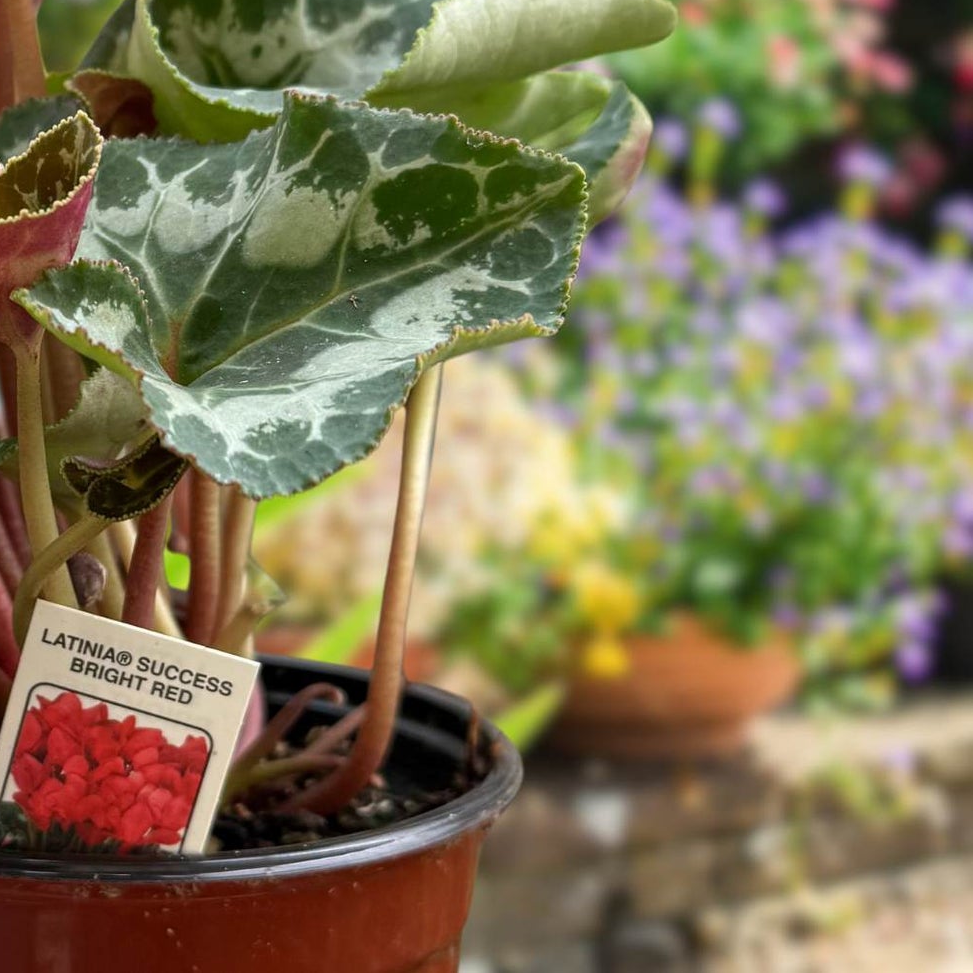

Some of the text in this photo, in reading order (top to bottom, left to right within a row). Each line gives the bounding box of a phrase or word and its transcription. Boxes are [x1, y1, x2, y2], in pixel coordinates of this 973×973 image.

[40, 628, 233, 696] LATINIA® SUCCESS
[69, 657, 193, 705] BRIGHT RED
